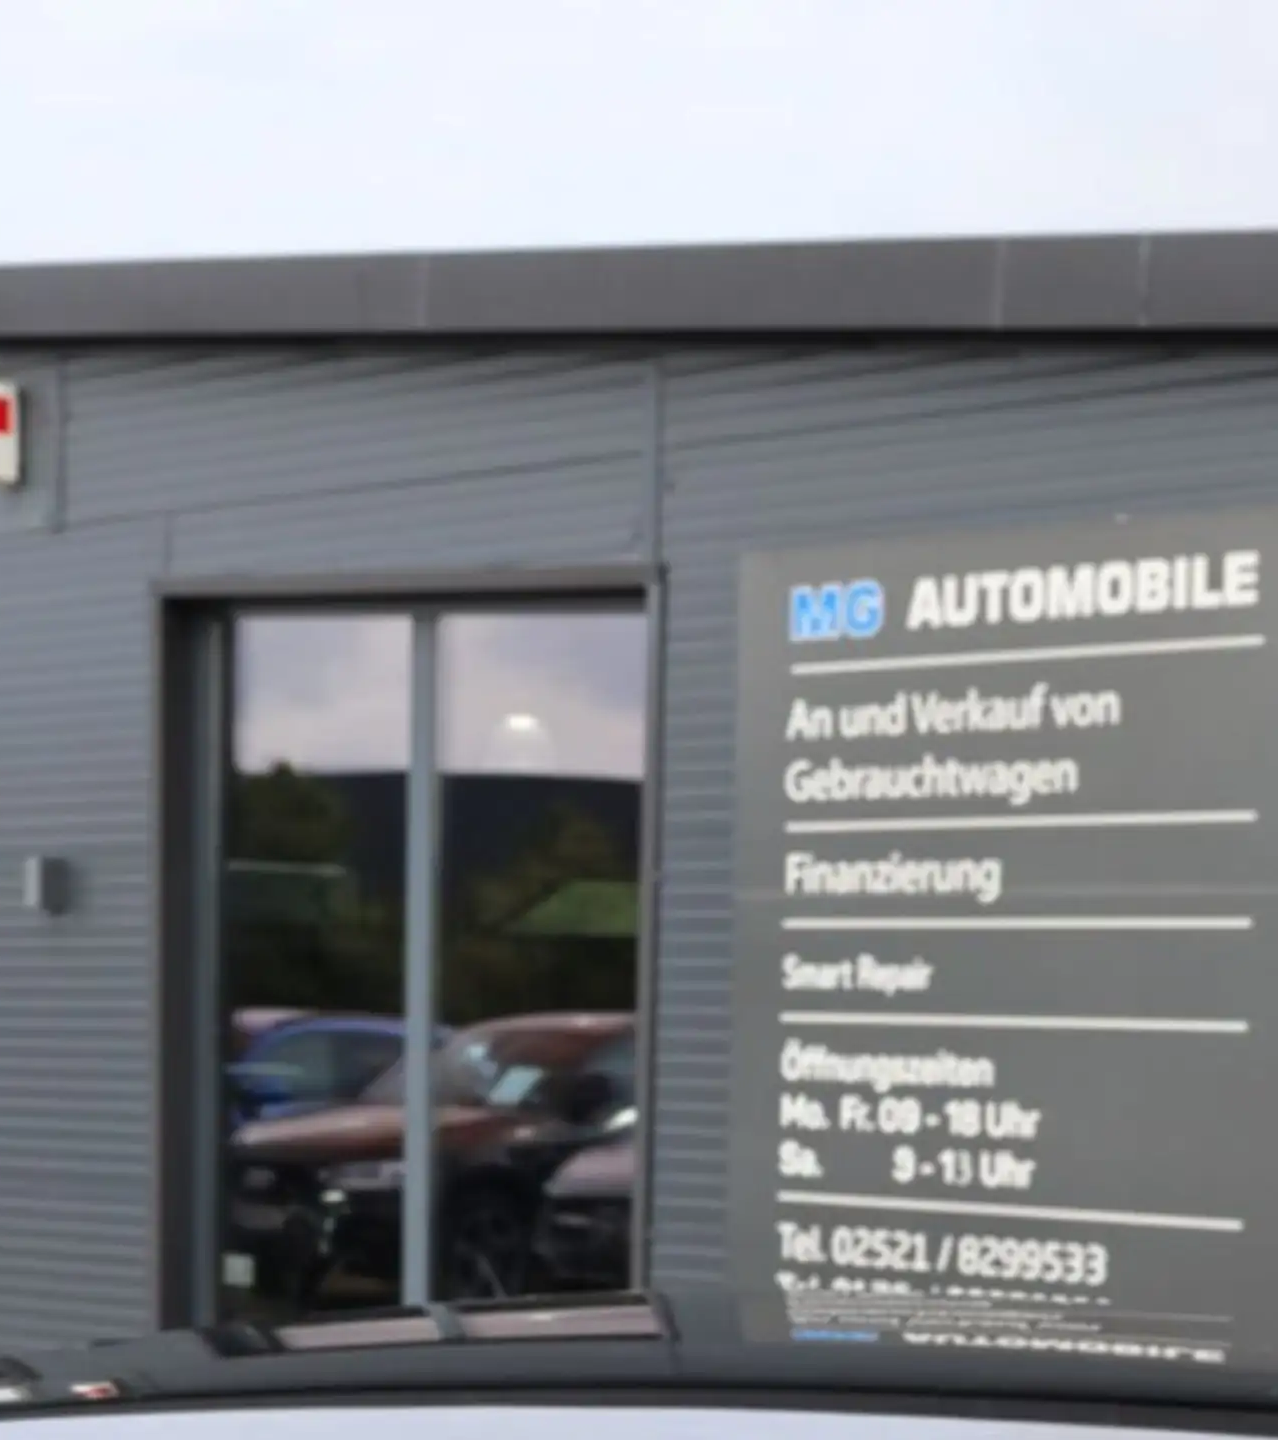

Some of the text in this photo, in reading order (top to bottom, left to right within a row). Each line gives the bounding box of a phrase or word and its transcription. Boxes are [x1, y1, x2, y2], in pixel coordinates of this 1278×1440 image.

[788, 549, 1261, 641] MG AUTOMOBILE
[786, 682, 1122, 740] An und Verkauf von
[784, 753, 1079, 806] Gebrauchtwagen
[784, 850, 1003, 905] Finanzierung
[781, 952, 934, 996] Smart Repair
[780, 1038, 996, 1092] Öffnungszeiten
[985, 1100, 1041, 1139] Uhr
[978, 1149, 1036, 1189] Uhr
[830, 1226, 931, 1273] 02521
[957, 1235, 1109, 1286] 8299533
